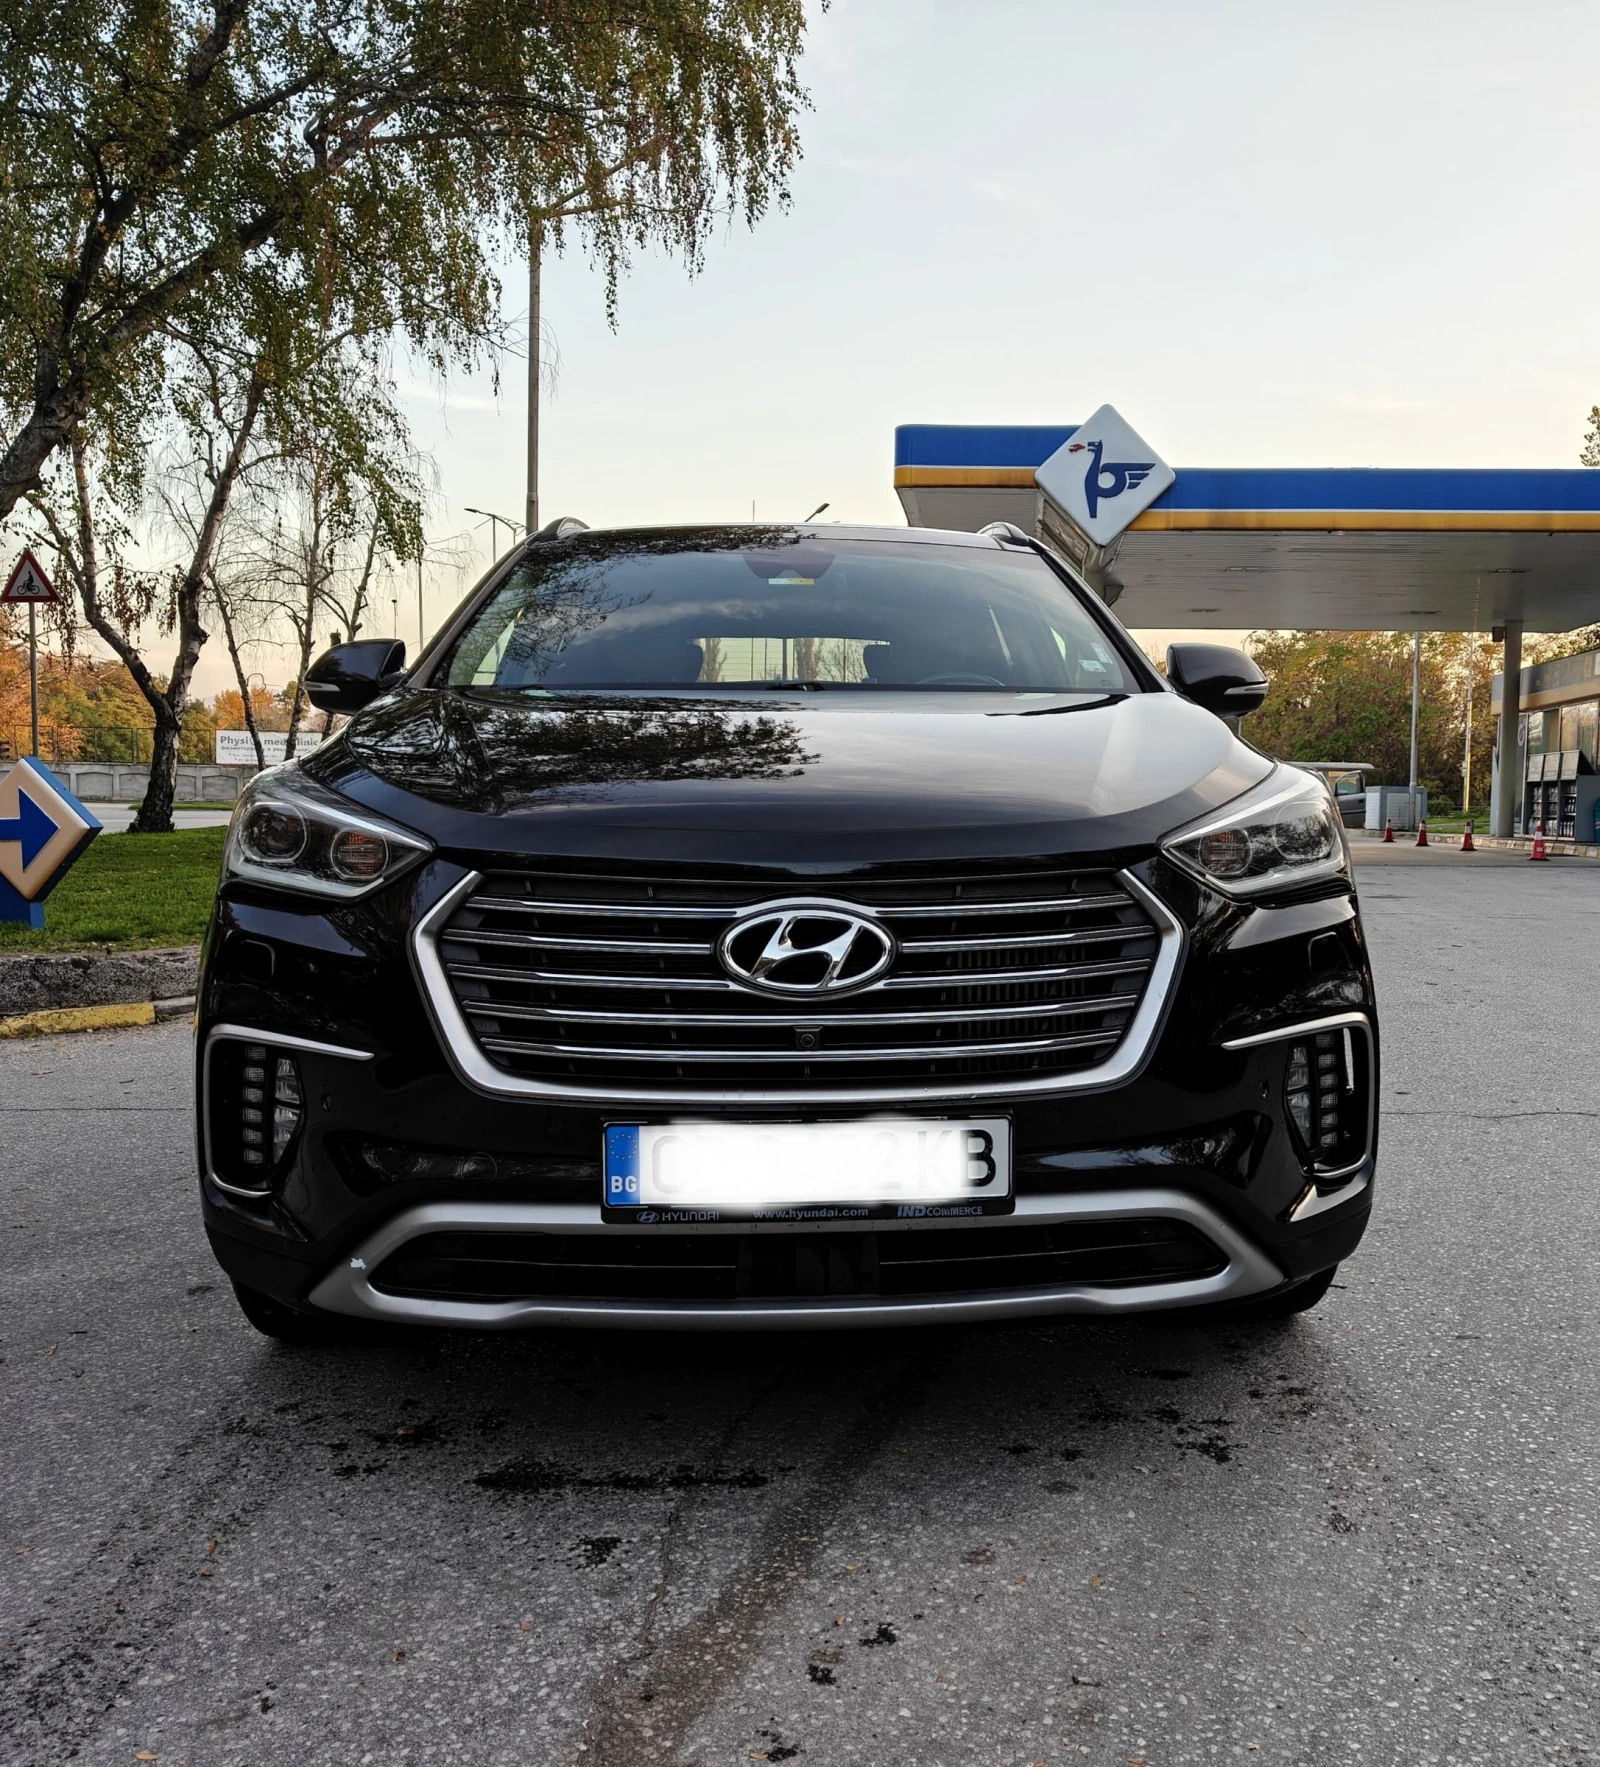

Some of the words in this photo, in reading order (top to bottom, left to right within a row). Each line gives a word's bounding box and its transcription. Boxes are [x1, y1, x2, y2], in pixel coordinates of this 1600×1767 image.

[295, 737, 319, 746] linic
[611, 1175, 637, 1193] BG
[662, 1211, 720, 1222] HYUNDAI
[753, 1206, 869, 1221] www.hyundai.com
